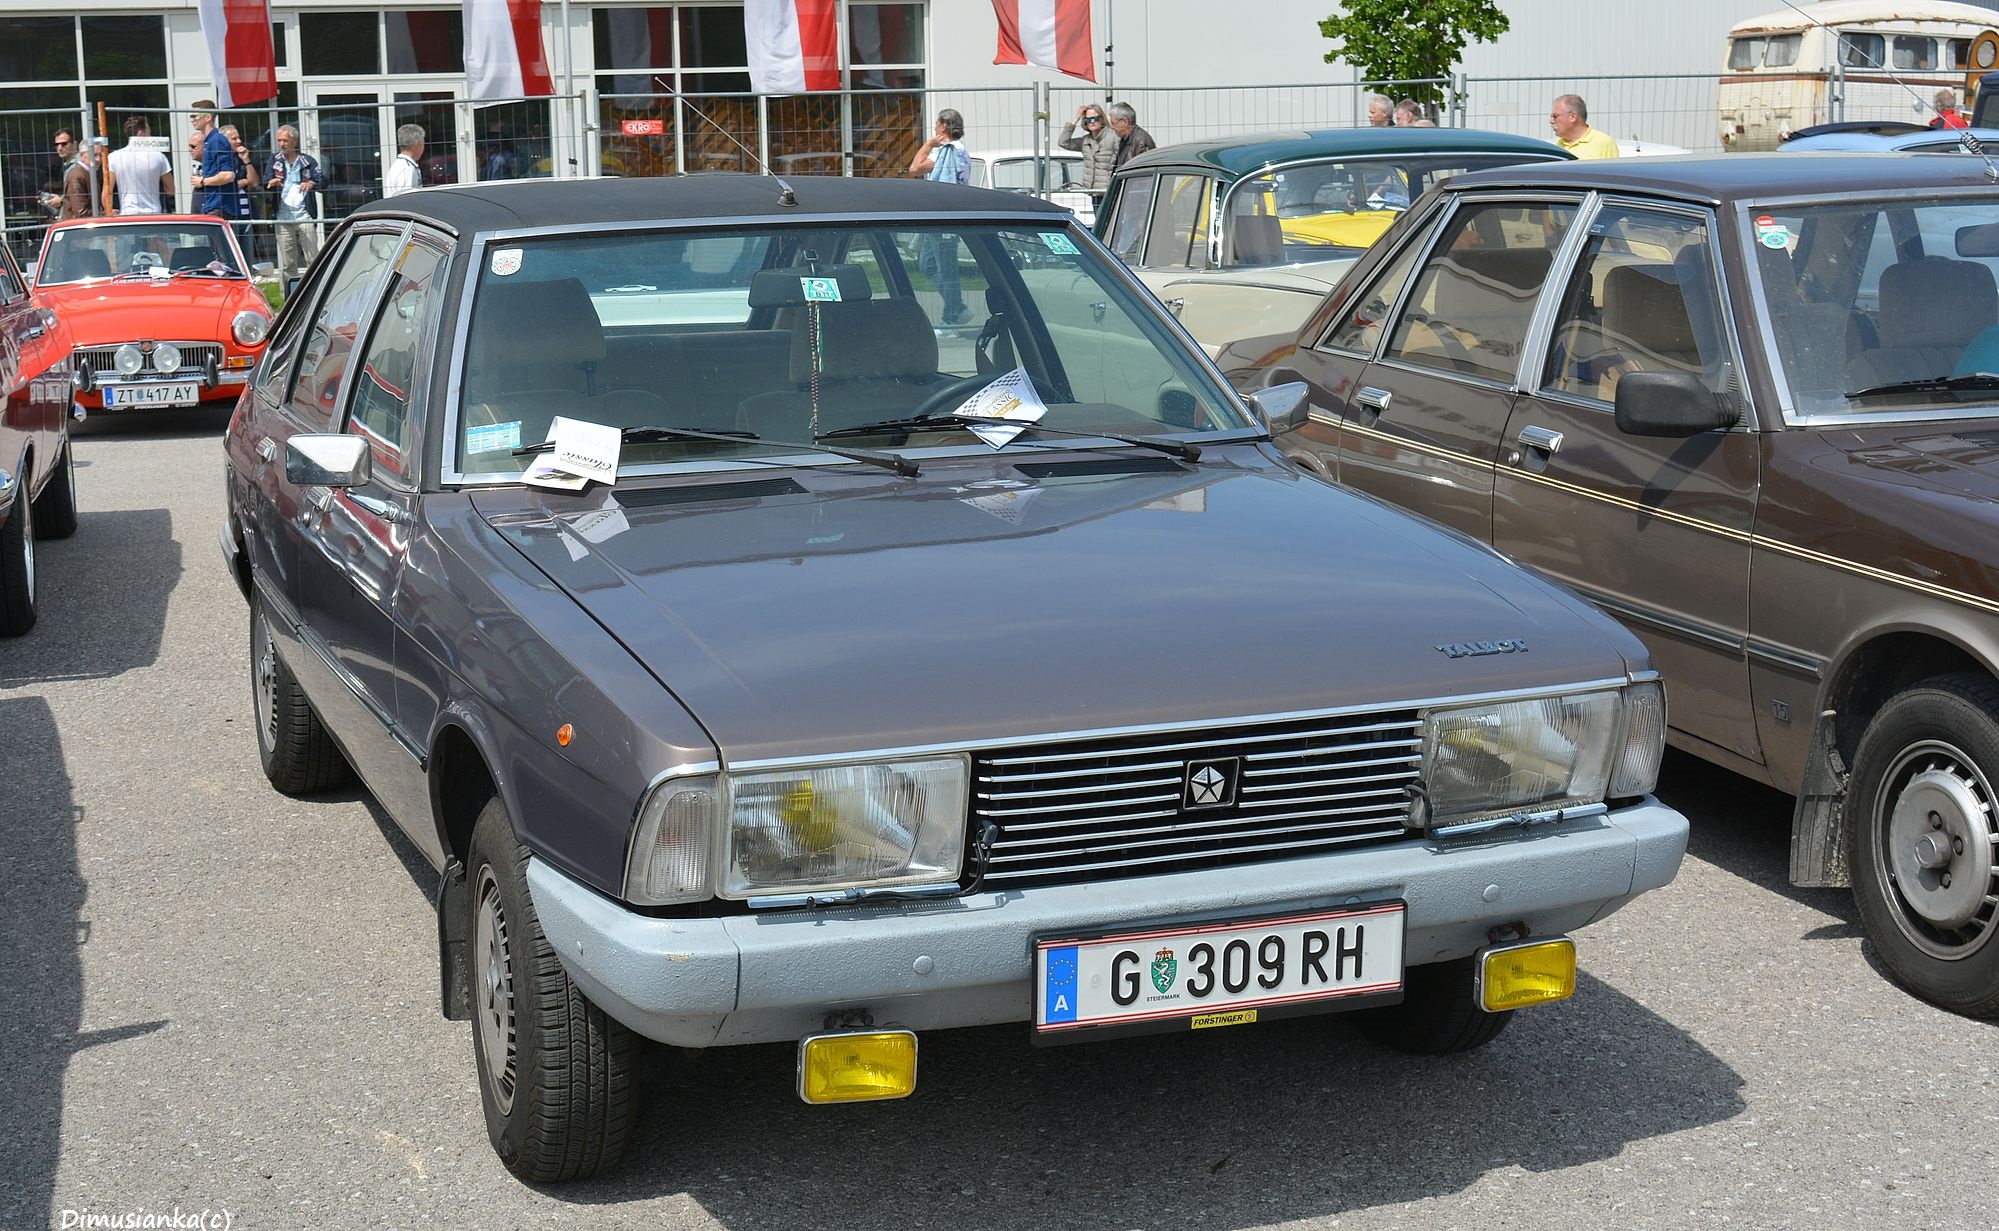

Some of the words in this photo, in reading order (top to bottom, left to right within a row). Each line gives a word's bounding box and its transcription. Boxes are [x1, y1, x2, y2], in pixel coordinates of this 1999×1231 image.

[117, 388, 134, 403] ZT
[146, 388, 170, 402] 417
[174, 386, 191, 401] AY
[1433, 637, 1529, 659] TALBOT
[1110, 950, 1141, 1007] G
[1186, 934, 1286, 998] 309
[1301, 924, 1364, 985] RH
[1053, 994, 1069, 1012] A
[1146, 993, 1181, 1003] STEIERMARK
[1193, 1013, 1243, 1027] FORSTINGER
